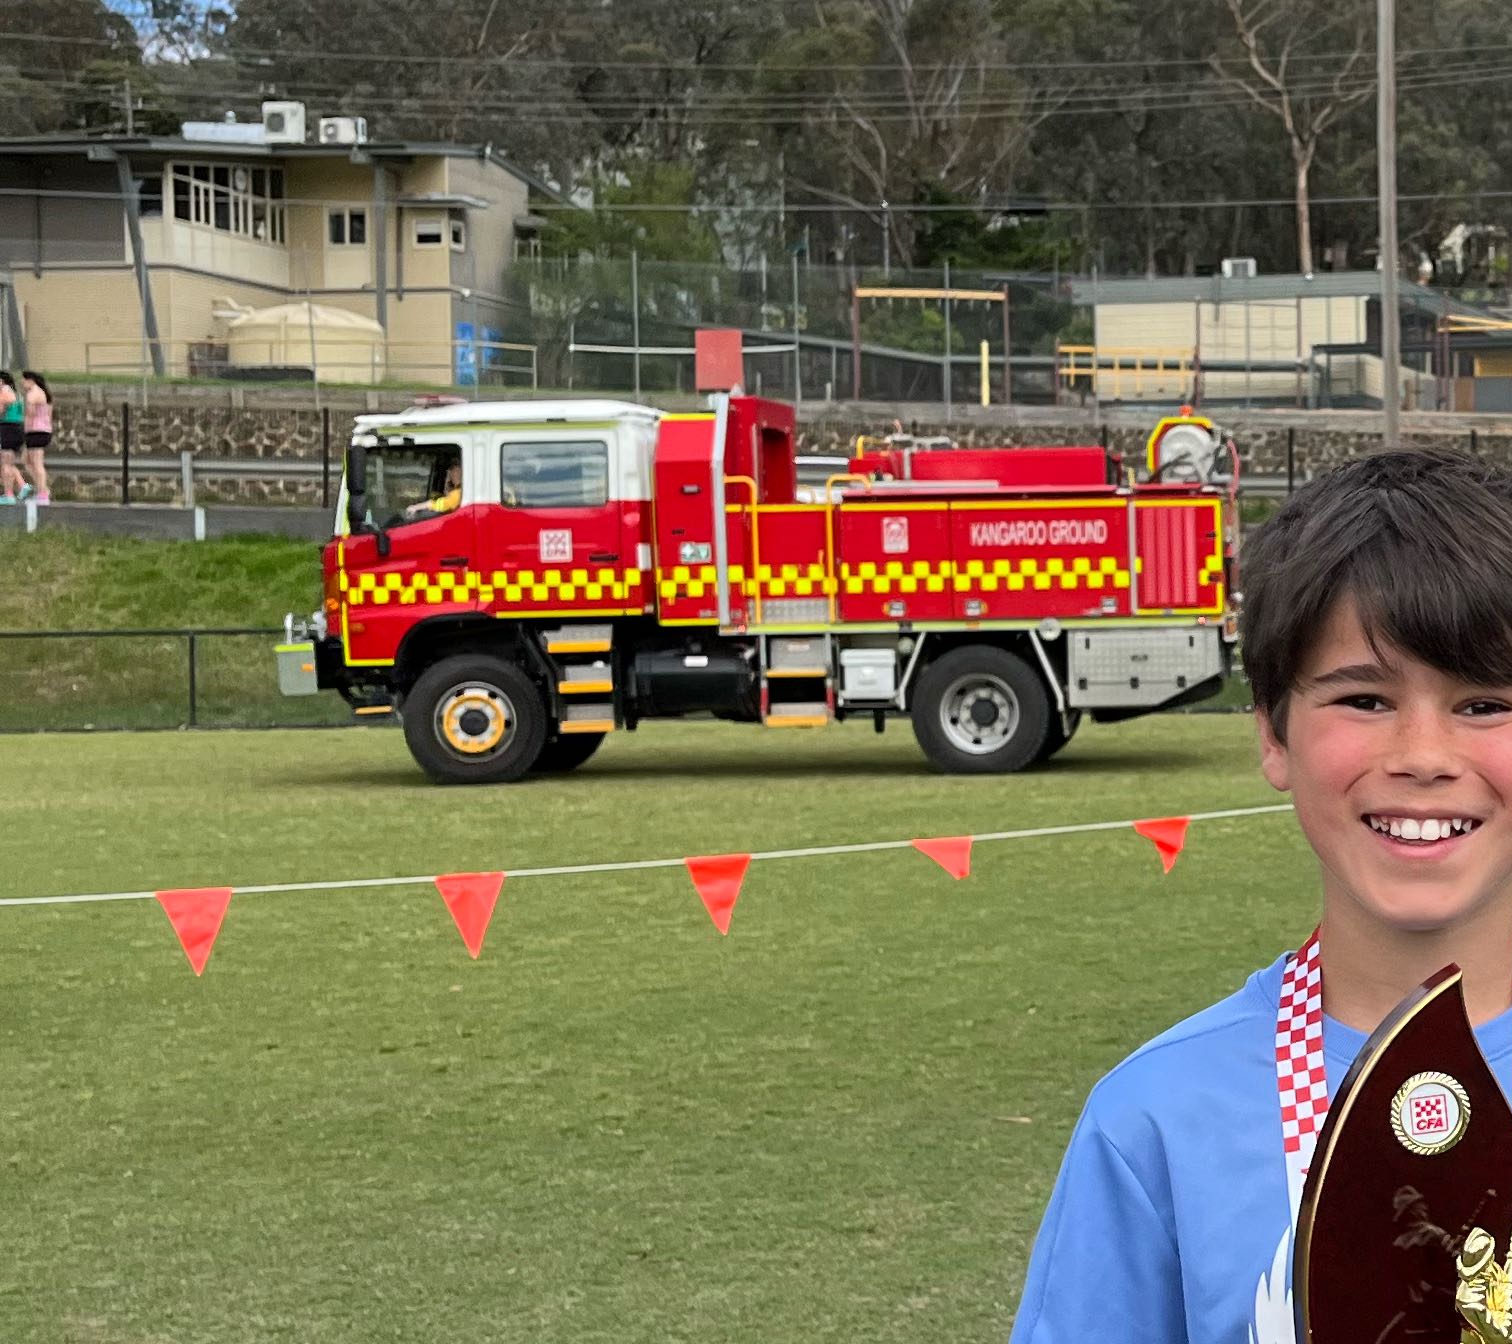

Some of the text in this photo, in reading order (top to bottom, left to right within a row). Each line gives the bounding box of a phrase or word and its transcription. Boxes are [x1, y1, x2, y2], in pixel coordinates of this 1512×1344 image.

[970, 518, 1108, 546] KANGAROO GROUND
[1416, 1117, 1443, 1130] CFA
